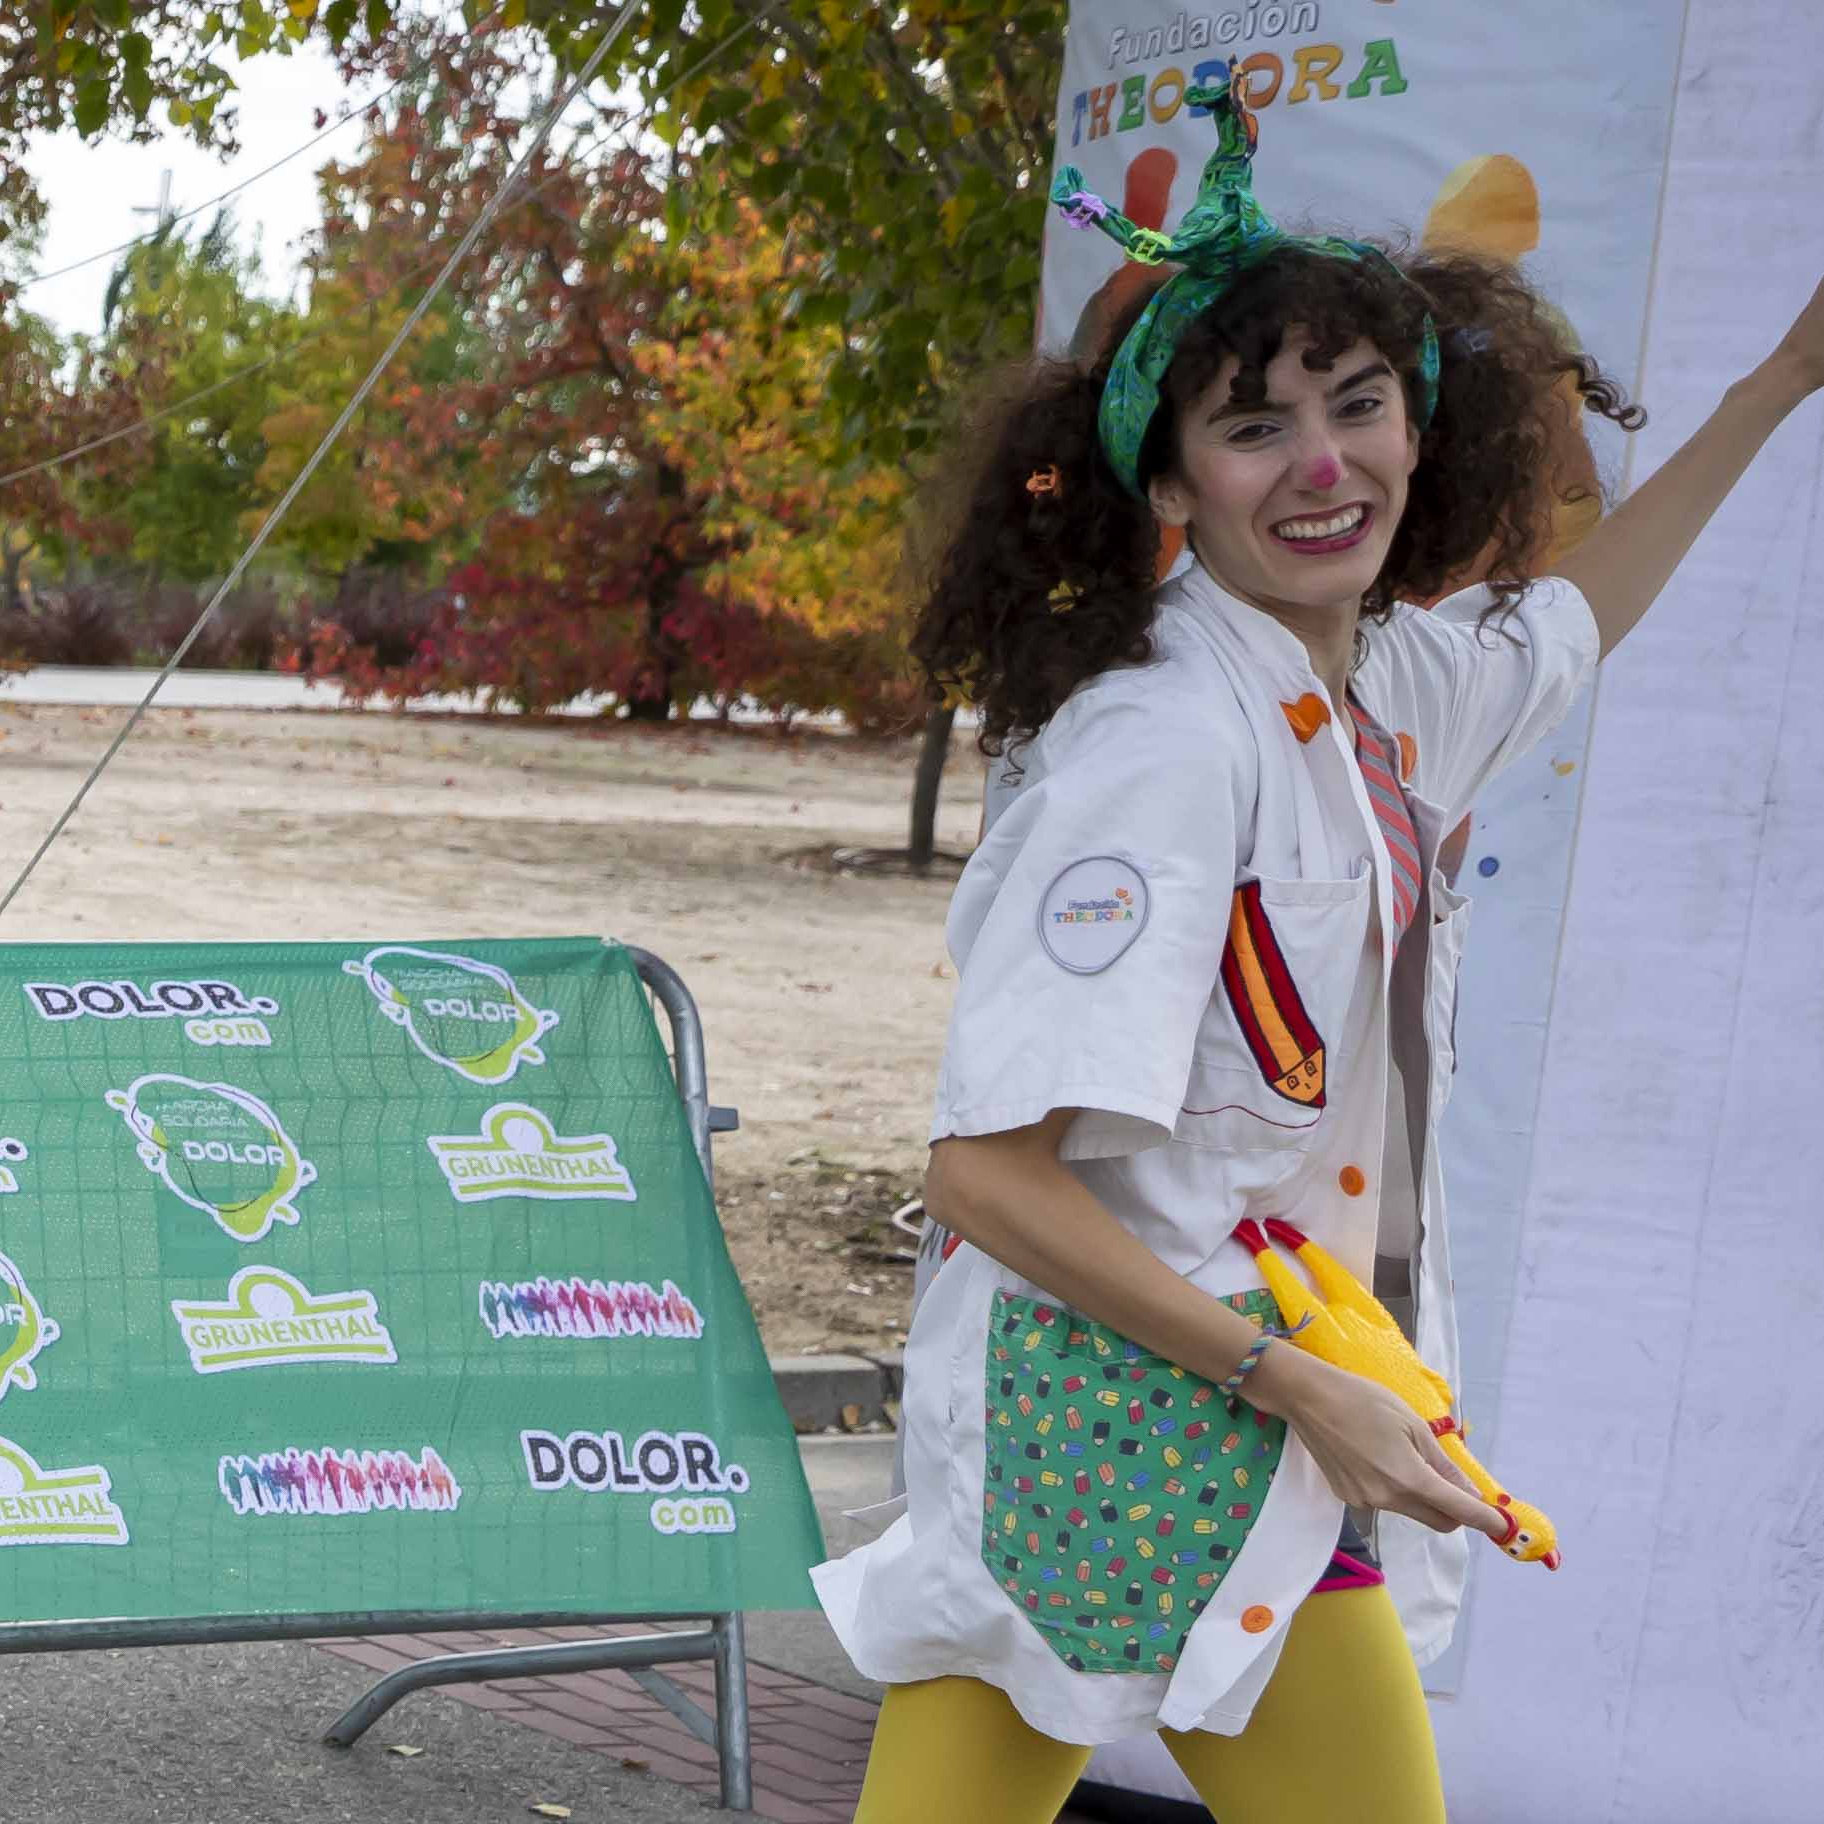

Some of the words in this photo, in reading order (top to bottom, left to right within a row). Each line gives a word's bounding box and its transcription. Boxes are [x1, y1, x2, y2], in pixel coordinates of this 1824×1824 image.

[1105, 0, 1320, 70] Fundación
[1071, 38, 1408, 148] THEODORA
[33, 984, 273, 1016] DOLOR.
[423, 998, 526, 1022] DOLOR
[192, 1021, 265, 1041] com
[183, 1140, 287, 1166] DOLOR
[448, 1153, 621, 1179] GRÜNENTHAL
[189, 1317, 381, 1351] GRÜNENTHAL
[529, 1437, 744, 1487] DOLOR.
[657, 1503, 732, 1527] com
